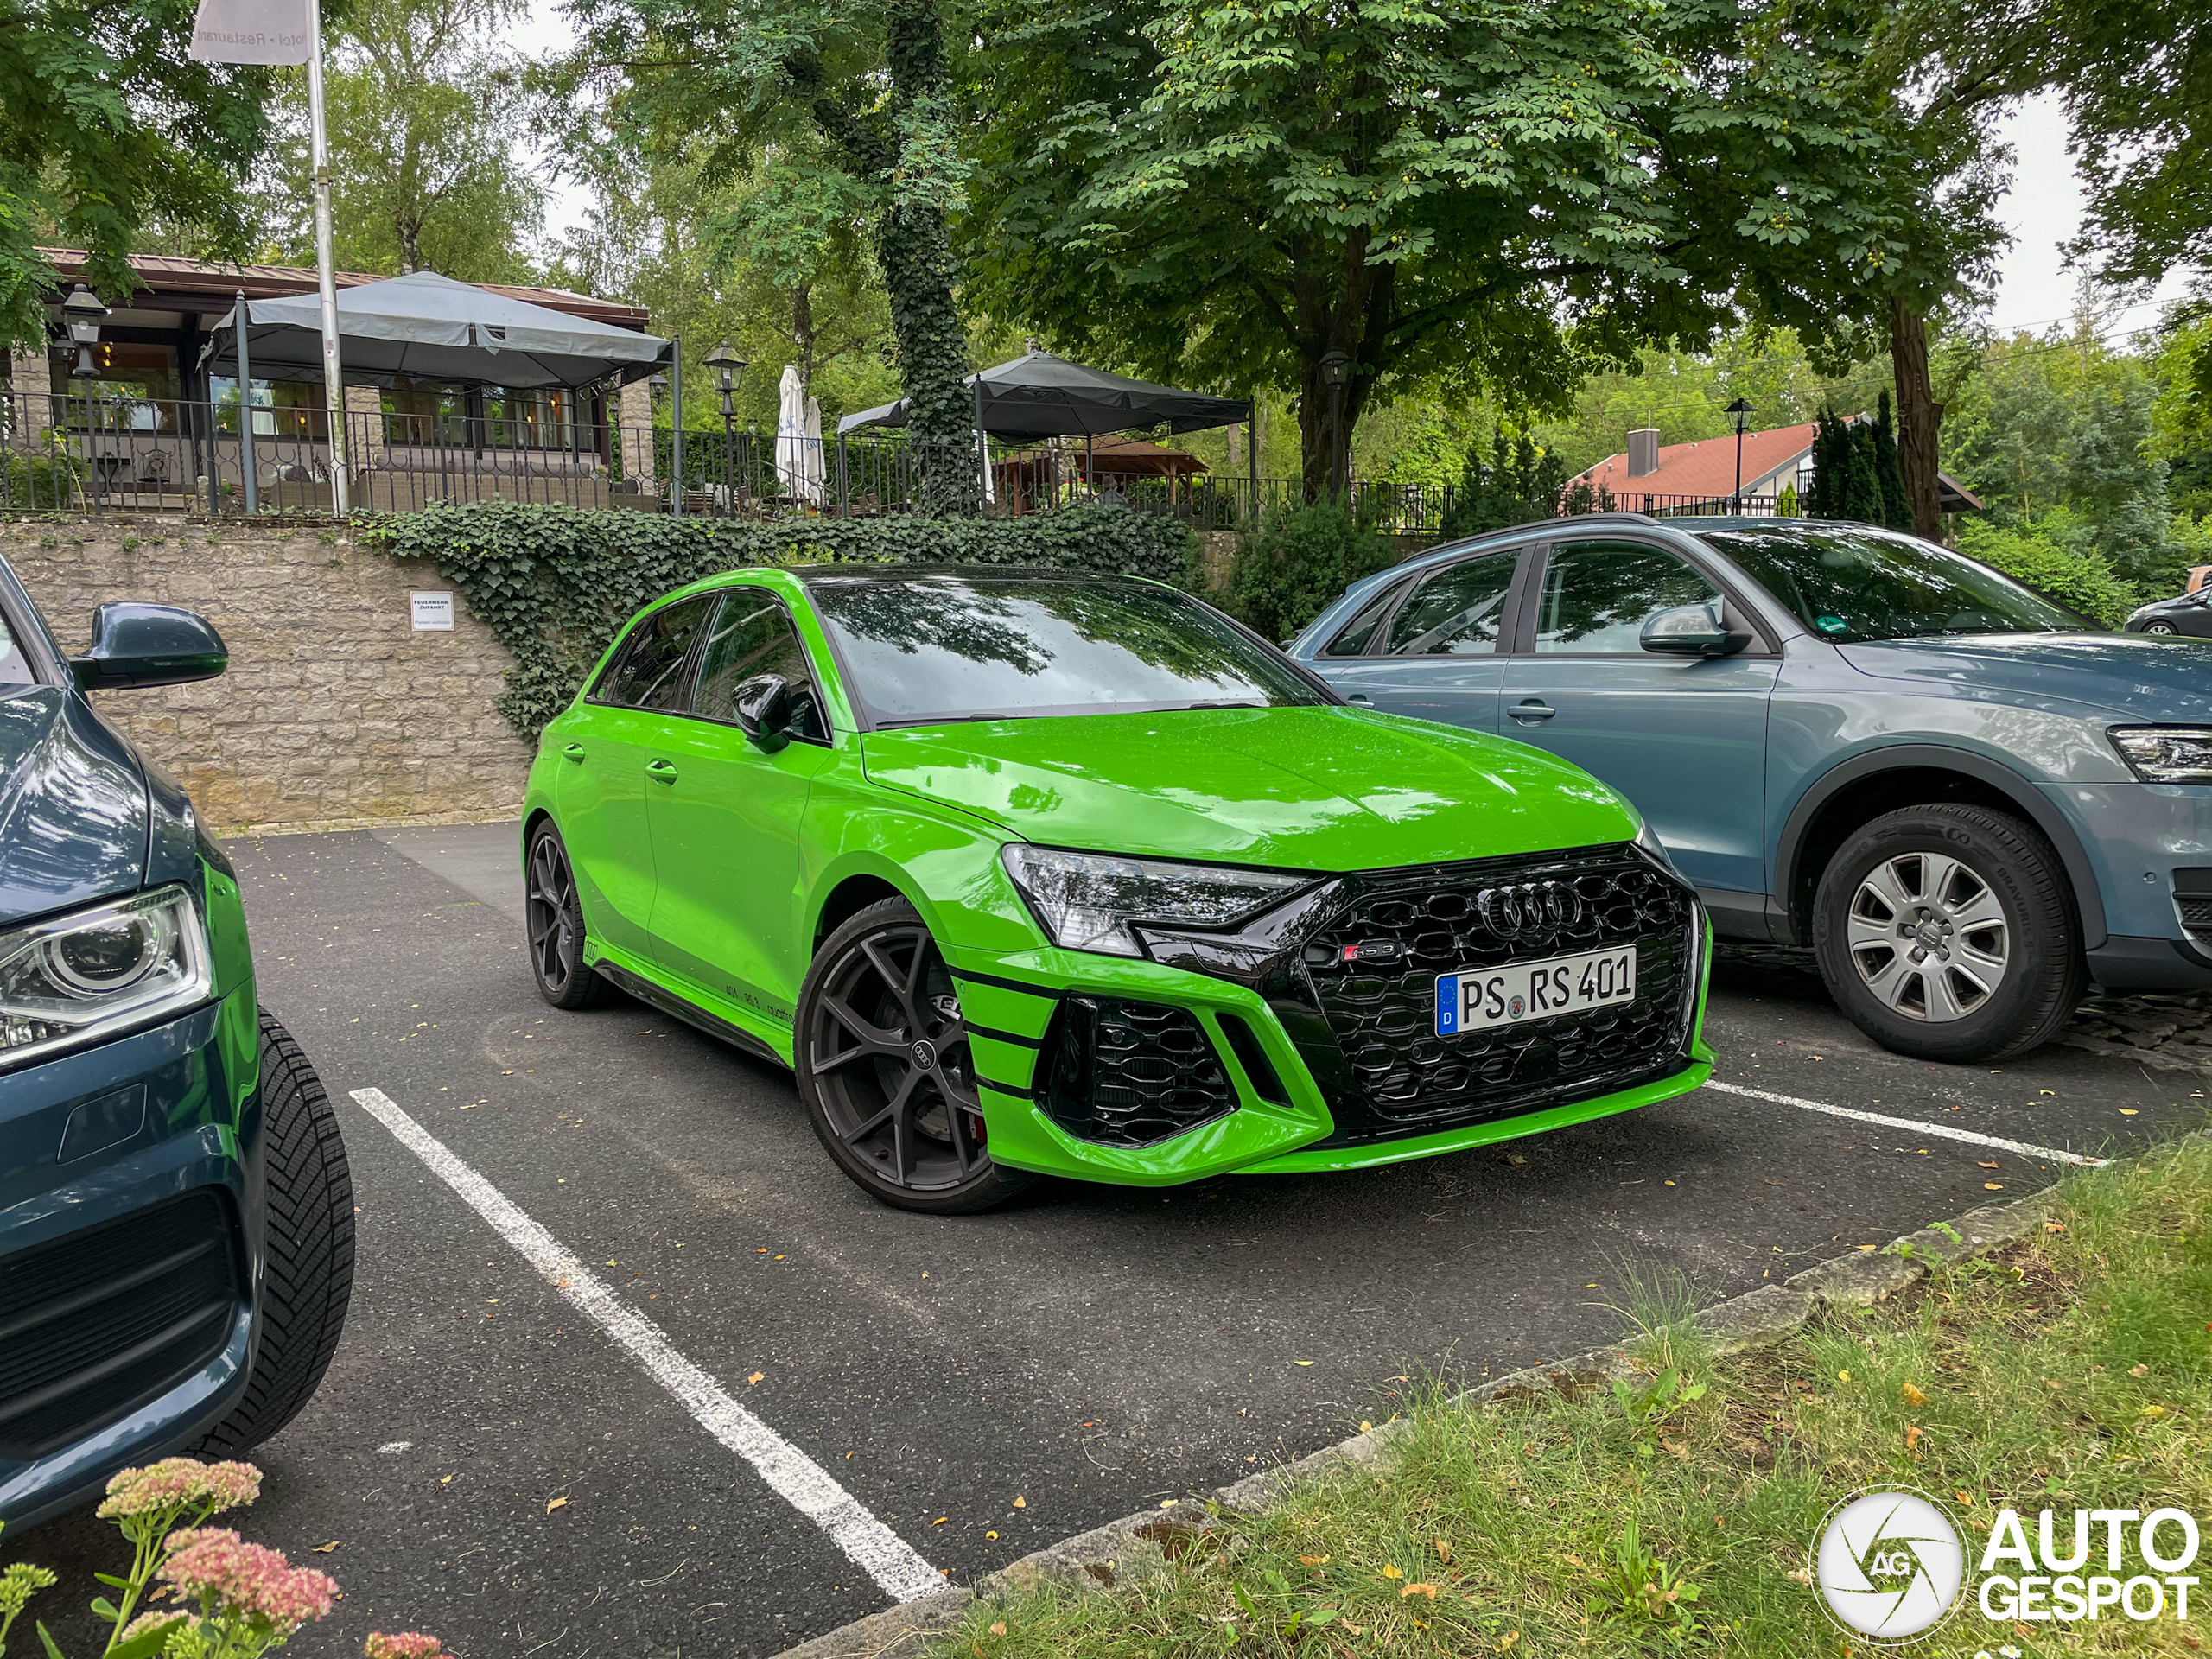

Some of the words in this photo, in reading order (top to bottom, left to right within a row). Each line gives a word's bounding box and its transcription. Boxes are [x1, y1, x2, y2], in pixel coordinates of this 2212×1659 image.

[1997, 868, 2031, 936] BRAVURIS
[1352, 946, 1378, 957] RS
[1382, 944, 1394, 954] 3
[726, 985, 739, 1000] 401
[767, 1005, 794, 1025] quattro
[1462, 977, 1505, 1024] PS
[1530, 966, 1570, 1013] RS
[1578, 955, 1631, 1001] 401
[1444, 1012, 1452, 1025] D
